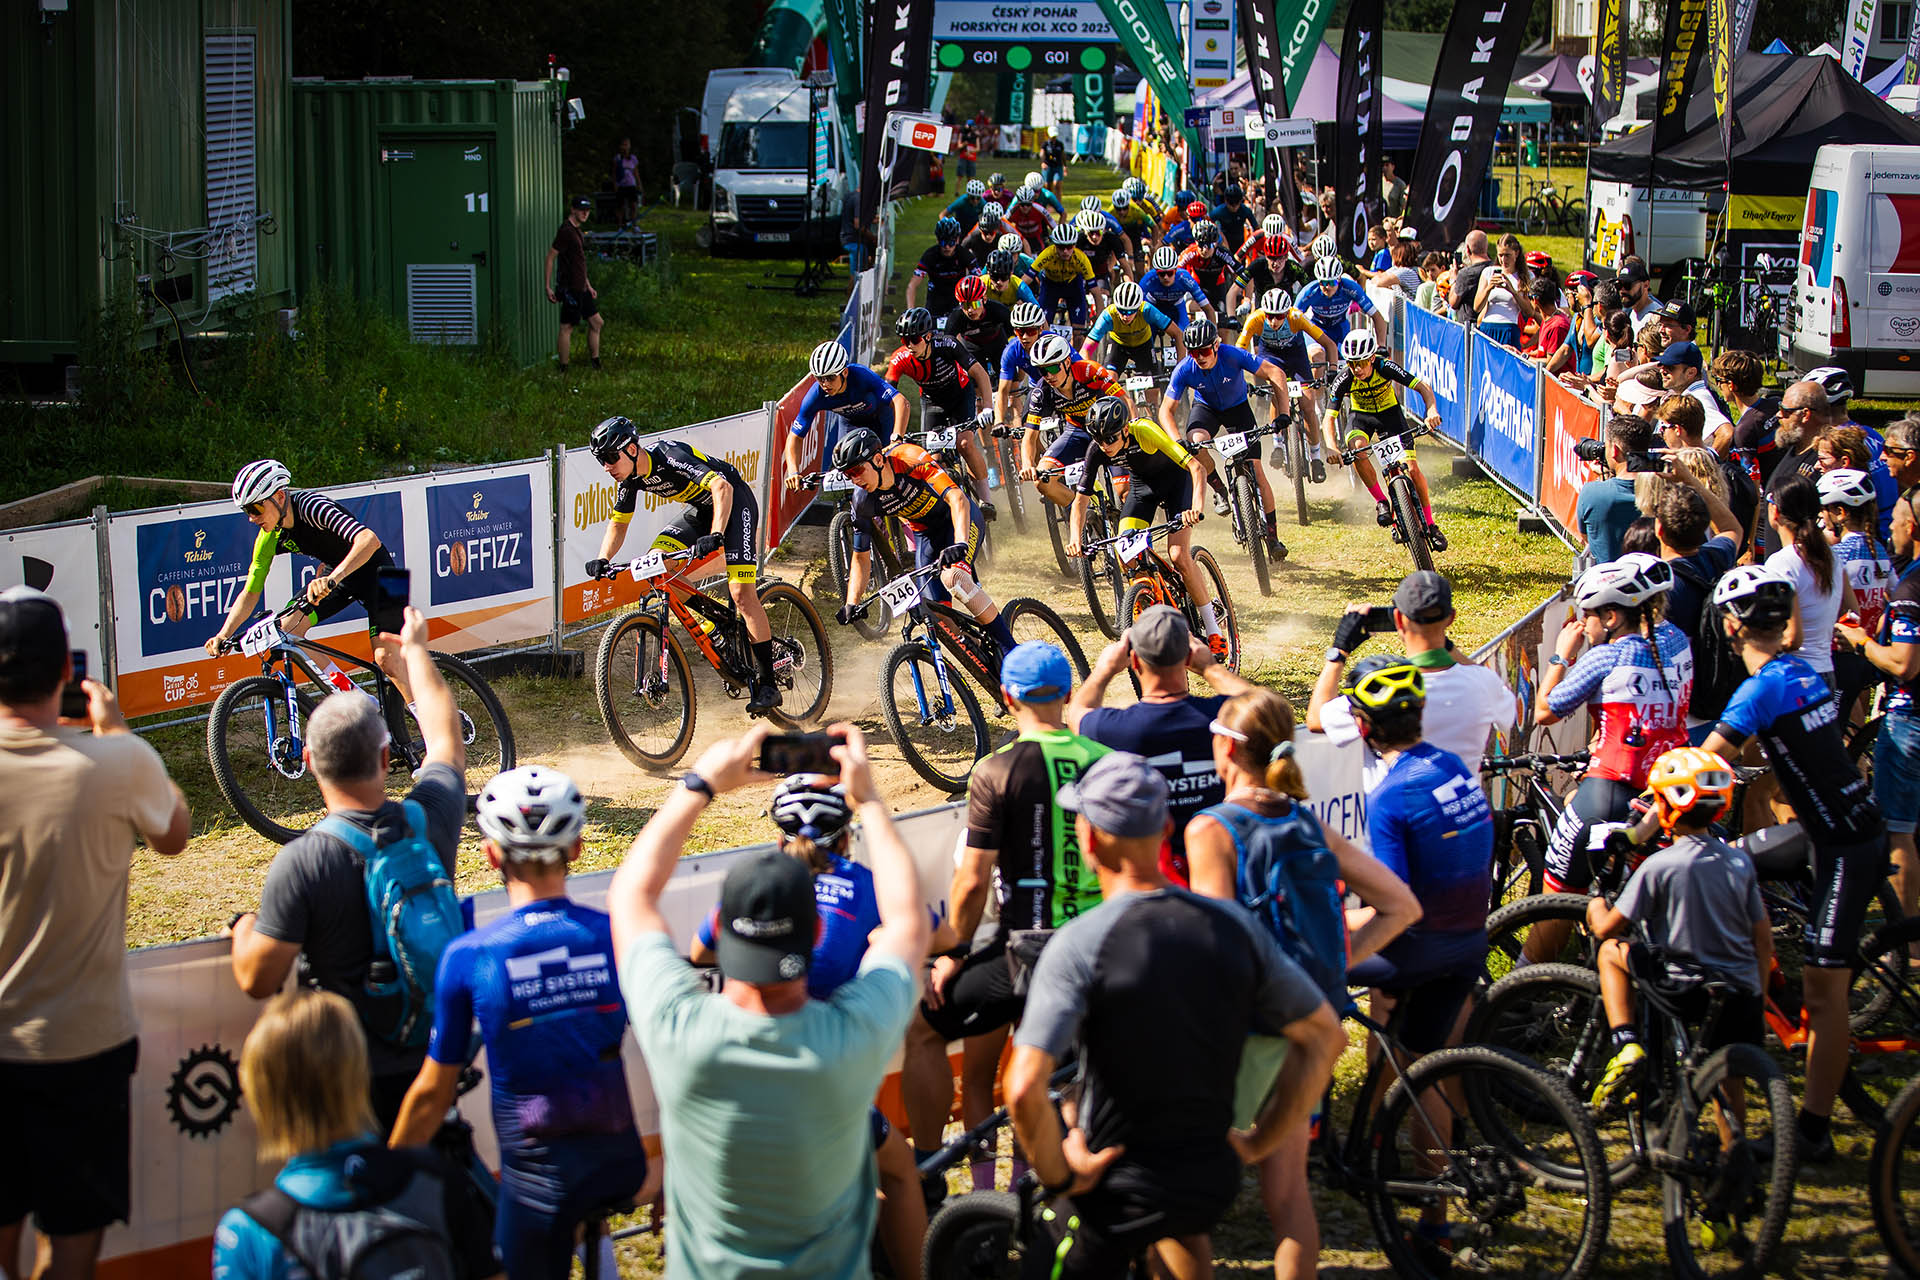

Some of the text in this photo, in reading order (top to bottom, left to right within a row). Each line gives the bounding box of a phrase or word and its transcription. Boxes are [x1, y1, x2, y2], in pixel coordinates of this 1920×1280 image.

[991, 5, 1078, 18] ČESKÝ POHÁR
[950, 20, 1112, 33] HORSKÝCH KOL XCO 2025
[972, 51, 998, 64] GO!
[1044, 51, 1069, 64] GO!
[1279, 128, 1312, 138] MTBIKER
[464, 192, 488, 213] 11
[1770, 211, 1797, 222] Energy
[1384, 360, 1408, 378] PEMAC
[930, 431, 954, 443] 265
[1219, 435, 1243, 452] 288
[1377, 441, 1400, 459] 205
[466, 510, 490, 522] Tchibo
[443, 521, 513, 539] CAFFEINE AND WATER
[184, 549, 214, 563] Tchibo
[158, 562, 242, 583] CAFFEINE AND WATER
[887, 583, 915, 606] 246
[965, 650, 989, 674] CRUZ
[165, 690, 186, 703] CUP
[1167, 774, 1222, 793] YSTEM
[1031, 803, 1044, 847] Racing
[544, 968, 611, 994] SYSTEM
